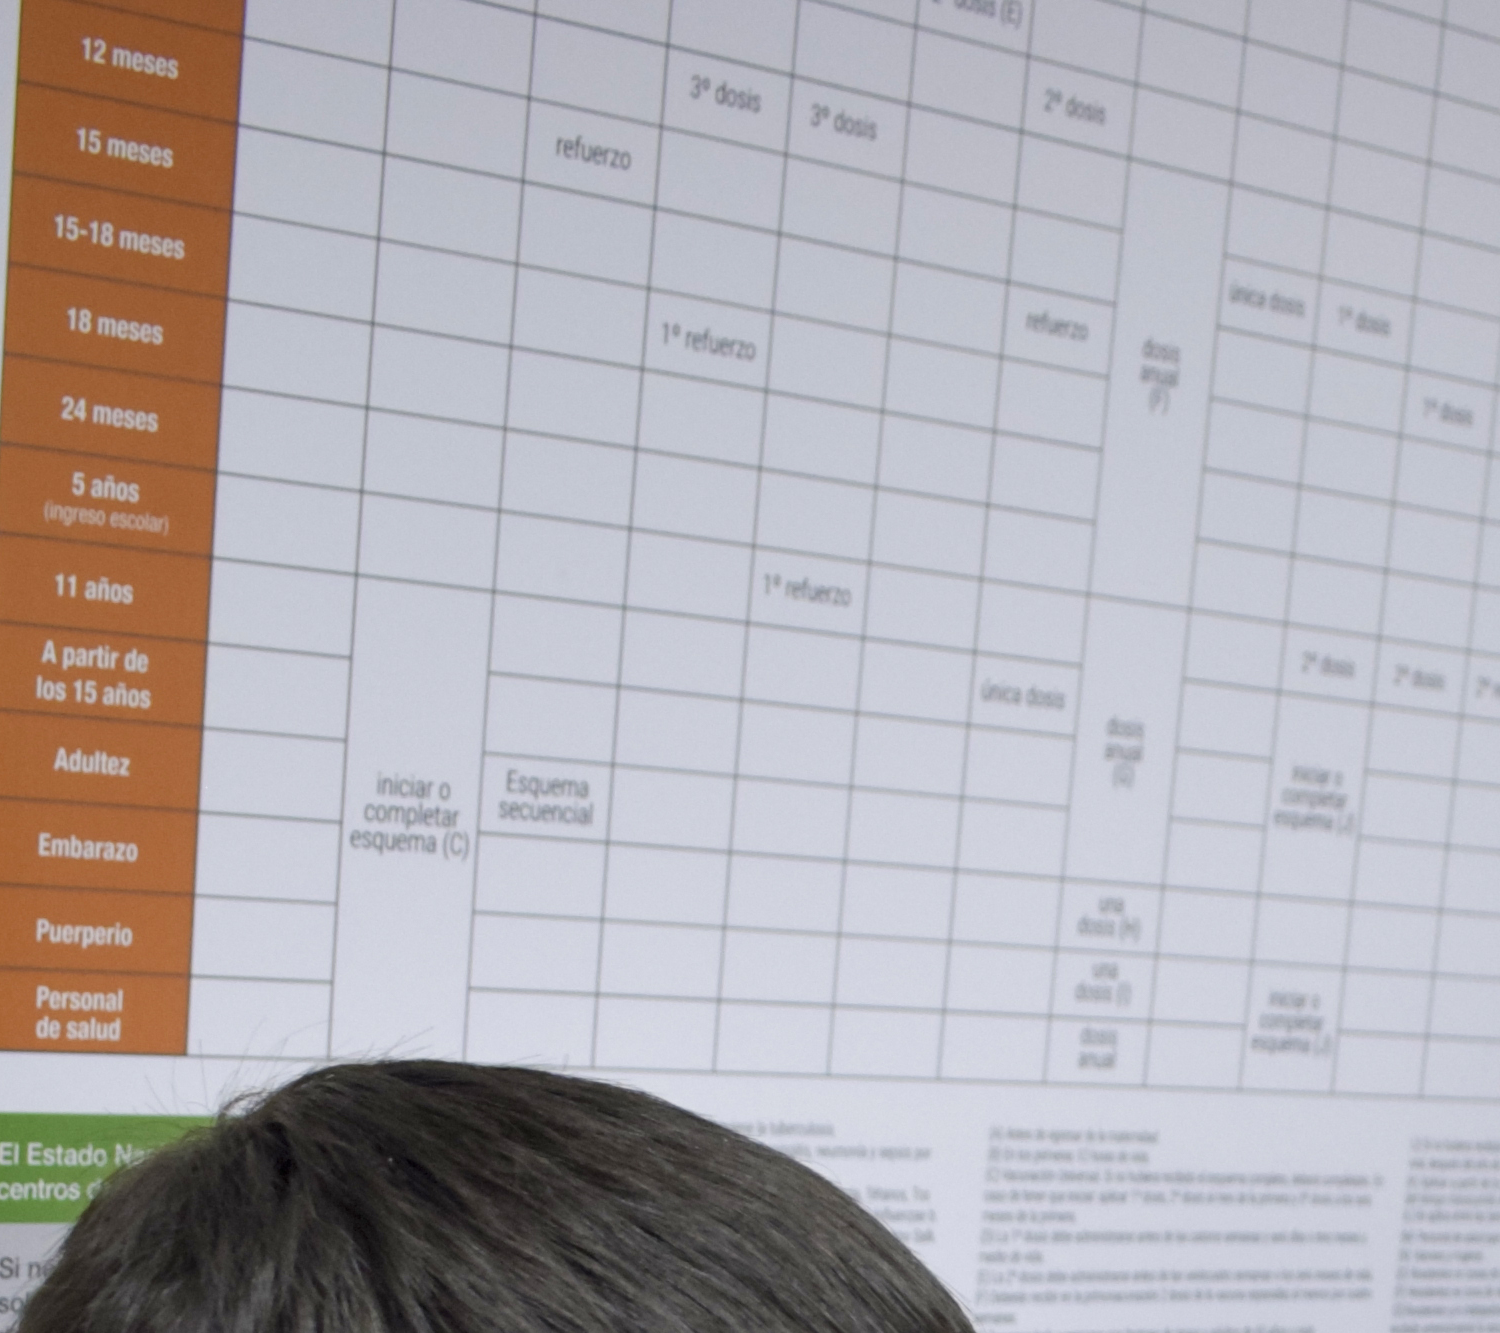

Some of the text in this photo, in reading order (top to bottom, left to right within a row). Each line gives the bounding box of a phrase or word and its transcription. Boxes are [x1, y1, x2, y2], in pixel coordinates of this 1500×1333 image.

[80, 37, 179, 80] 12 meses
[715, 81, 762, 113] dosis
[1065, 93, 1106, 126] dosis
[834, 109, 877, 141] dosis
[77, 127, 173, 168] 15 meses
[556, 133, 632, 171] refuerzo
[55, 214, 185, 260] 15-18 meses
[67, 307, 164, 345] 18 meses
[685, 326, 756, 362] refuerzo
[61, 396, 158, 433] 24 meses
[72, 473, 140, 502] 5 años
[43, 500, 169, 536] (ingreso escolar)
[55, 574, 134, 604] 11 años
[785, 576, 852, 606] refuerzo
[42, 641, 149, 673] A partir de
[36, 676, 151, 710] los 15 años
[54, 748, 130, 777] Adultez
[376, 771, 451, 801] iniciar o
[506, 769, 589, 802] Esquema
[364, 799, 460, 830] completar
[499, 798, 594, 827] secuencial
[38, 832, 138, 863] Embarazo
[350, 827, 470, 861] esquema (C)
[36, 918, 133, 948] Puerperio
[36, 985, 123, 1012] Personal
[36, 1014, 121, 1041] de salud
[26, 1143, 108, 1168] Estado
[0, 1257, 21, 1280] Si
